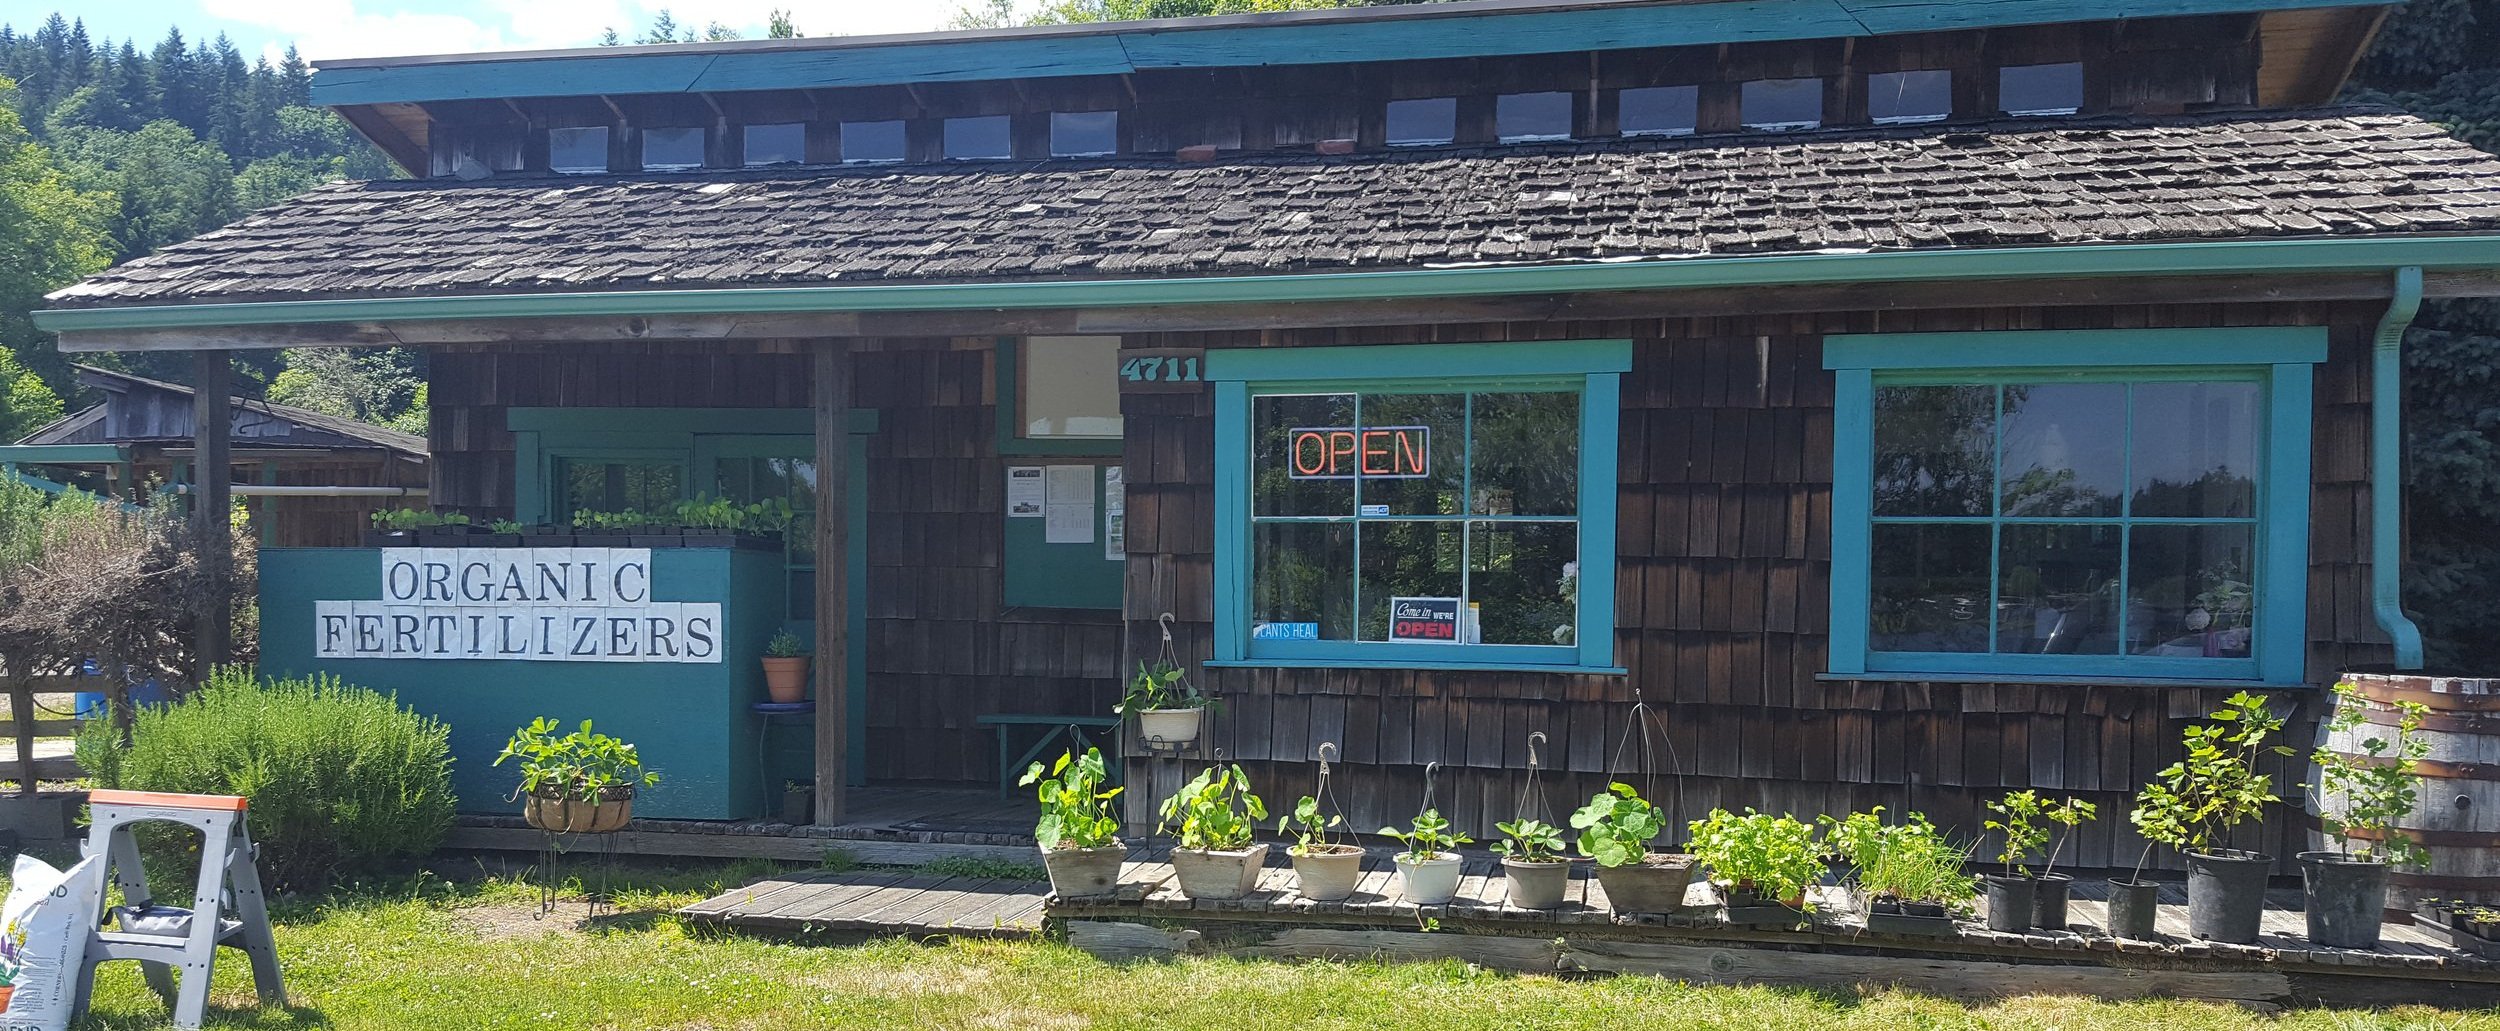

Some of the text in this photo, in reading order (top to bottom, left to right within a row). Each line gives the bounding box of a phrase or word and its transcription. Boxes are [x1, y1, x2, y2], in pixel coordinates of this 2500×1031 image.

[1120, 356, 1199, 382] 4711
[1294, 430, 1424, 475] OPEN
[388, 561, 646, 602] ORGANIC
[1397, 602, 1454, 620] Come in WE'RE
[321, 614, 714, 658] FERTILIZERS
[1260, 623, 1318, 638] LANTS HEAL
[1396, 621, 1453, 638] OPEN
